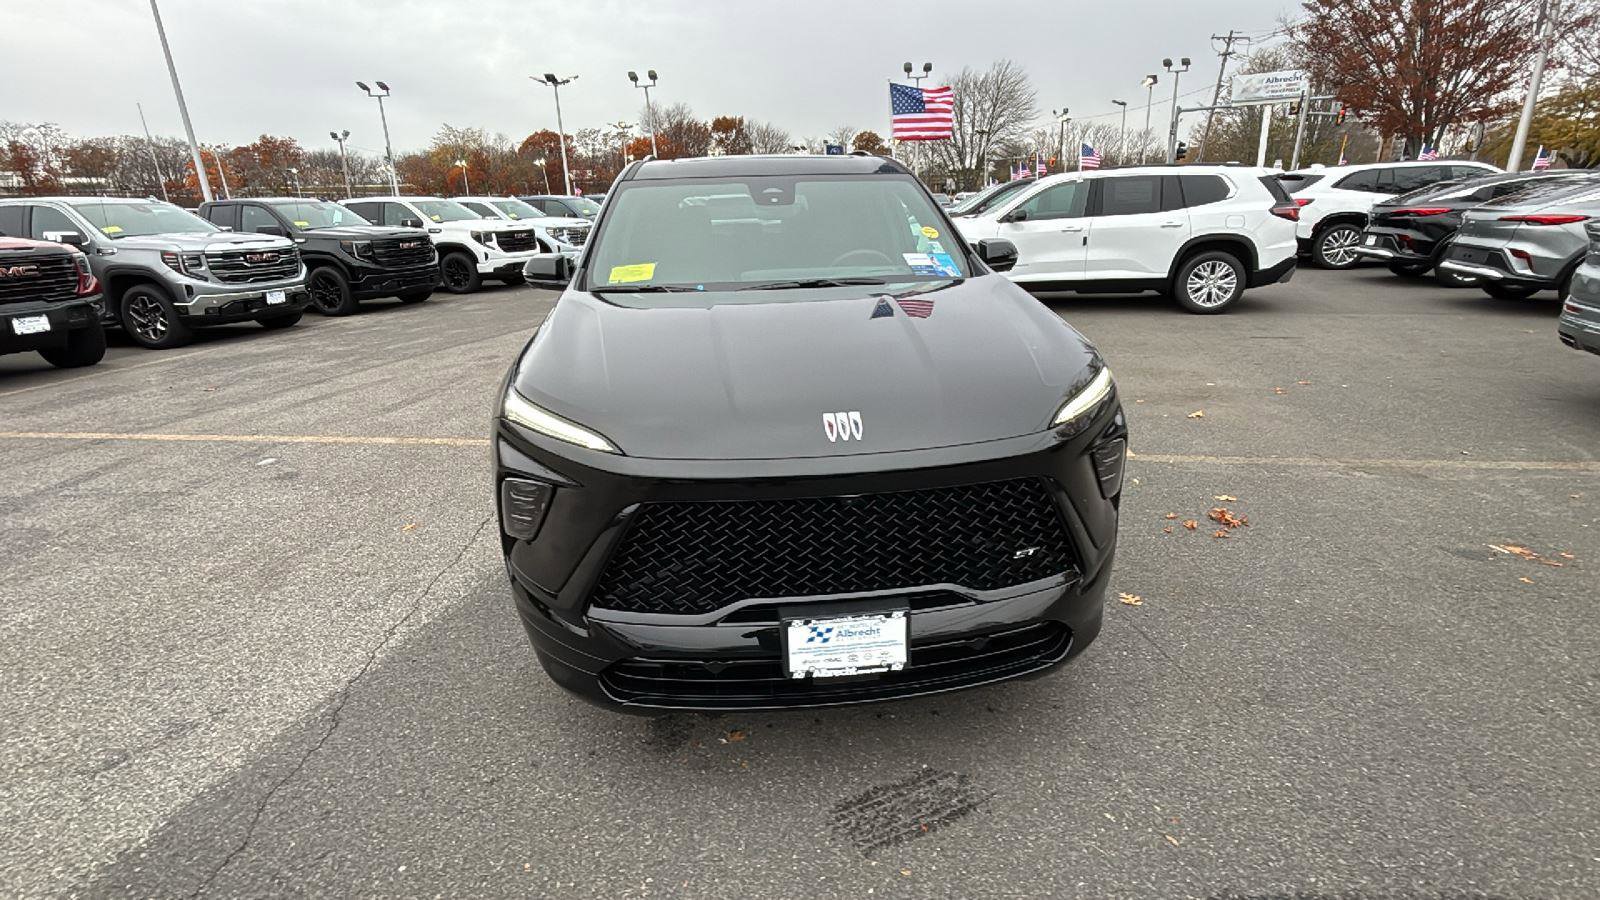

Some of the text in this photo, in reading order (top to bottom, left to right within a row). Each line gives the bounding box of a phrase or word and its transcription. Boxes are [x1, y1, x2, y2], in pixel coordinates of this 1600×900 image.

[1265, 71, 1303, 84] Albrecht
[246, 252, 279, 263] GMC
[0, 265, 40, 278] MC
[835, 626, 881, 638] Albrecht
